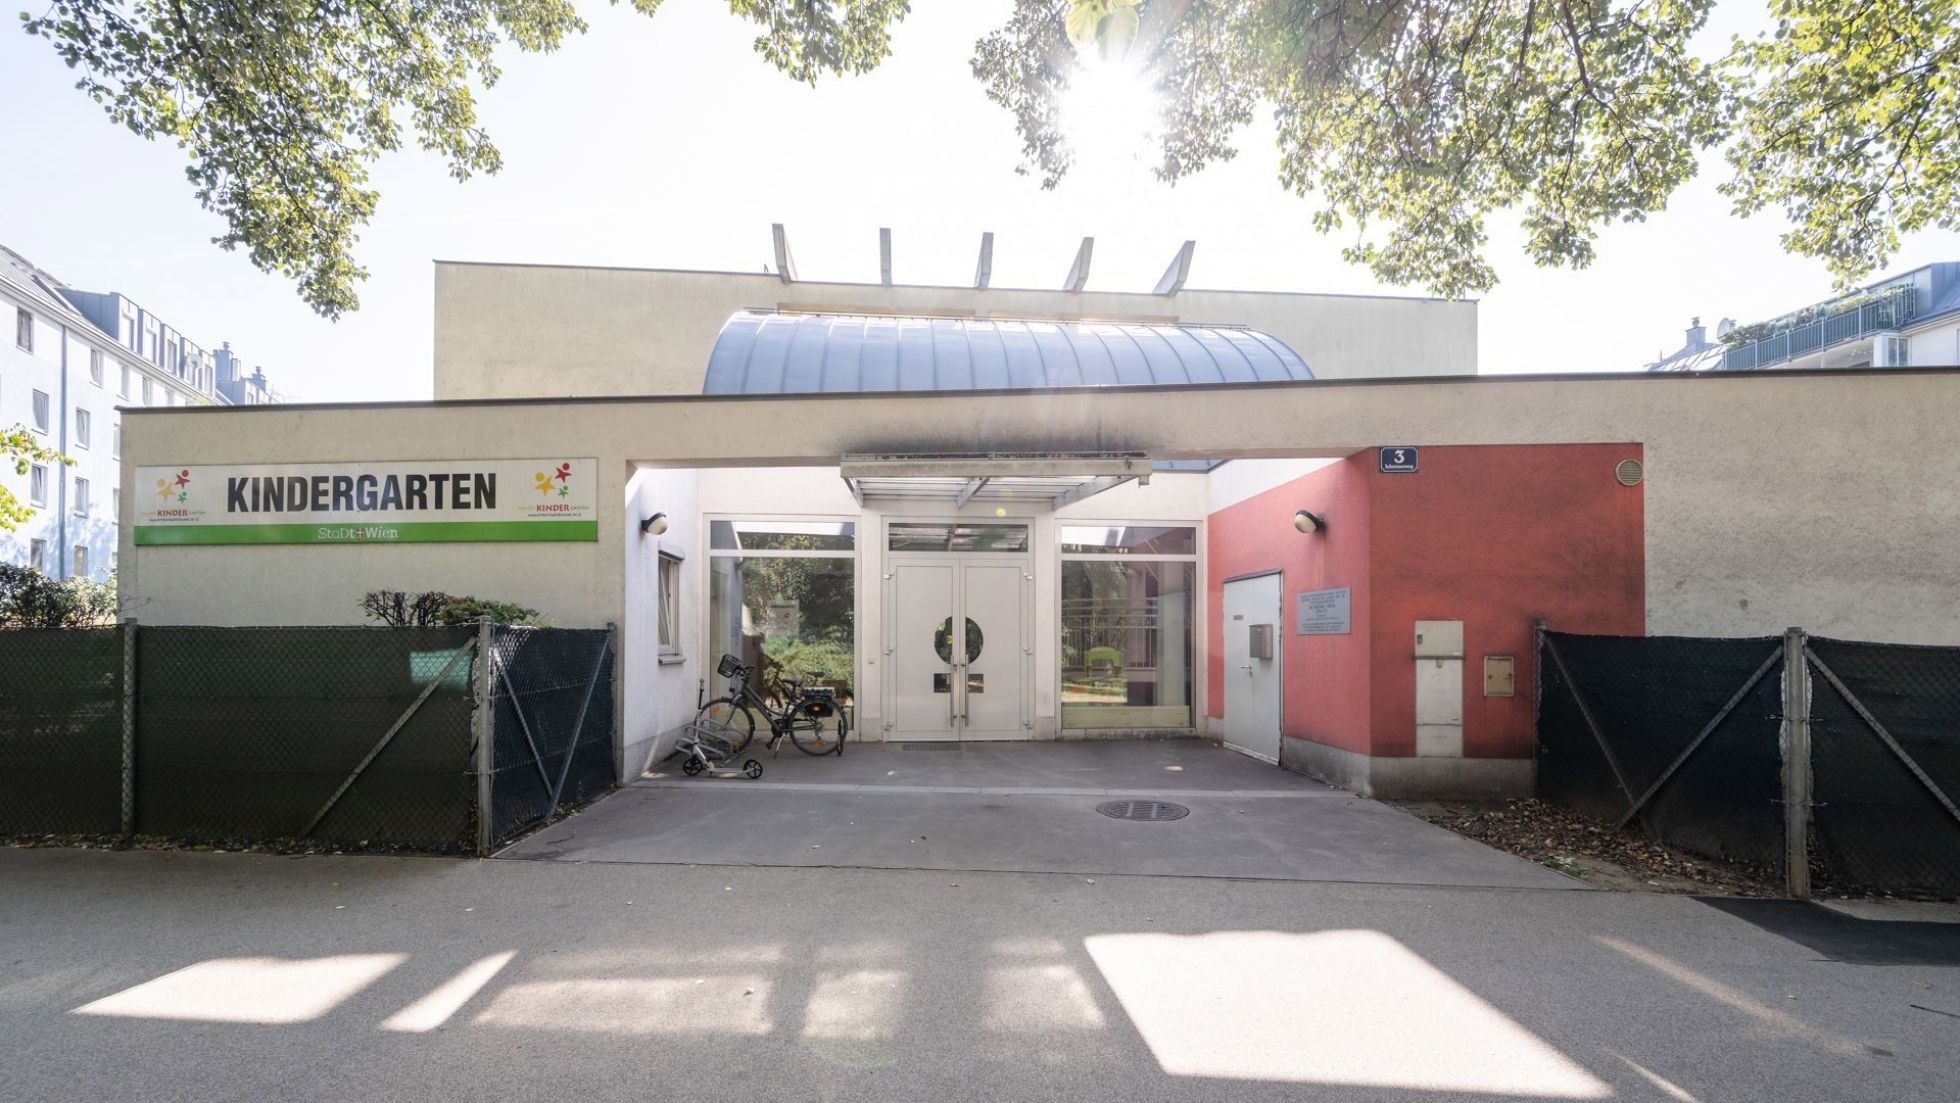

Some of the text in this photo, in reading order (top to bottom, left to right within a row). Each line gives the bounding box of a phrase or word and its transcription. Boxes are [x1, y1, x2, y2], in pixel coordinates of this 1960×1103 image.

[1394, 450, 1405, 464] 3
[227, 472, 497, 513] KINDERGARTEN
[157, 508, 188, 517] KINDER
[536, 503, 570, 512] KINDER
